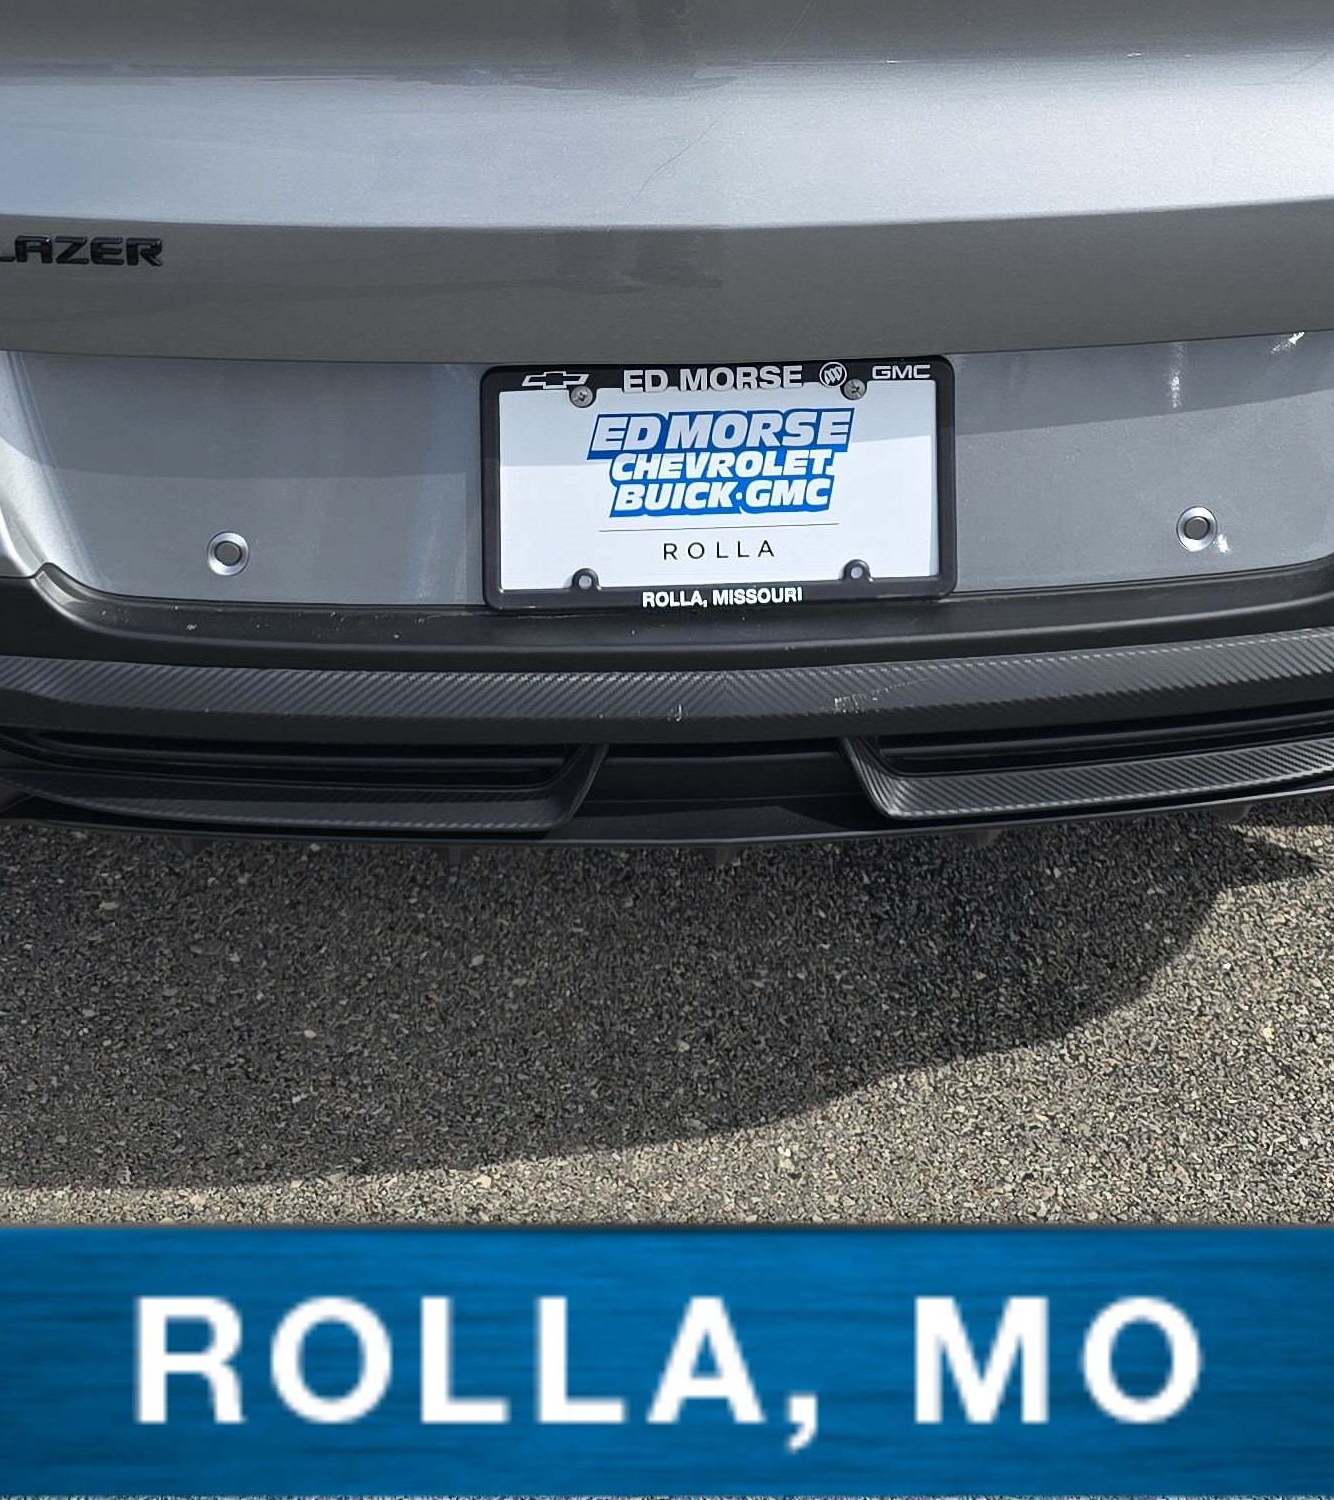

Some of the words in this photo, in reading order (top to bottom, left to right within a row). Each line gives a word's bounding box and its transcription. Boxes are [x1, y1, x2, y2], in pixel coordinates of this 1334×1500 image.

[623, 368, 668, 394] ED
[678, 365, 803, 392] MORSE
[871, 364, 931, 380] GMC
[590, 415, 661, 452] ED
[668, 410, 852, 450] MORSE
[610, 450, 833, 483] CHEVROLET
[662, 539, 775, 562] ROLLA
[641, 591, 708, 609] ROLLA,
[712, 585, 804, 606] MISSOURI
